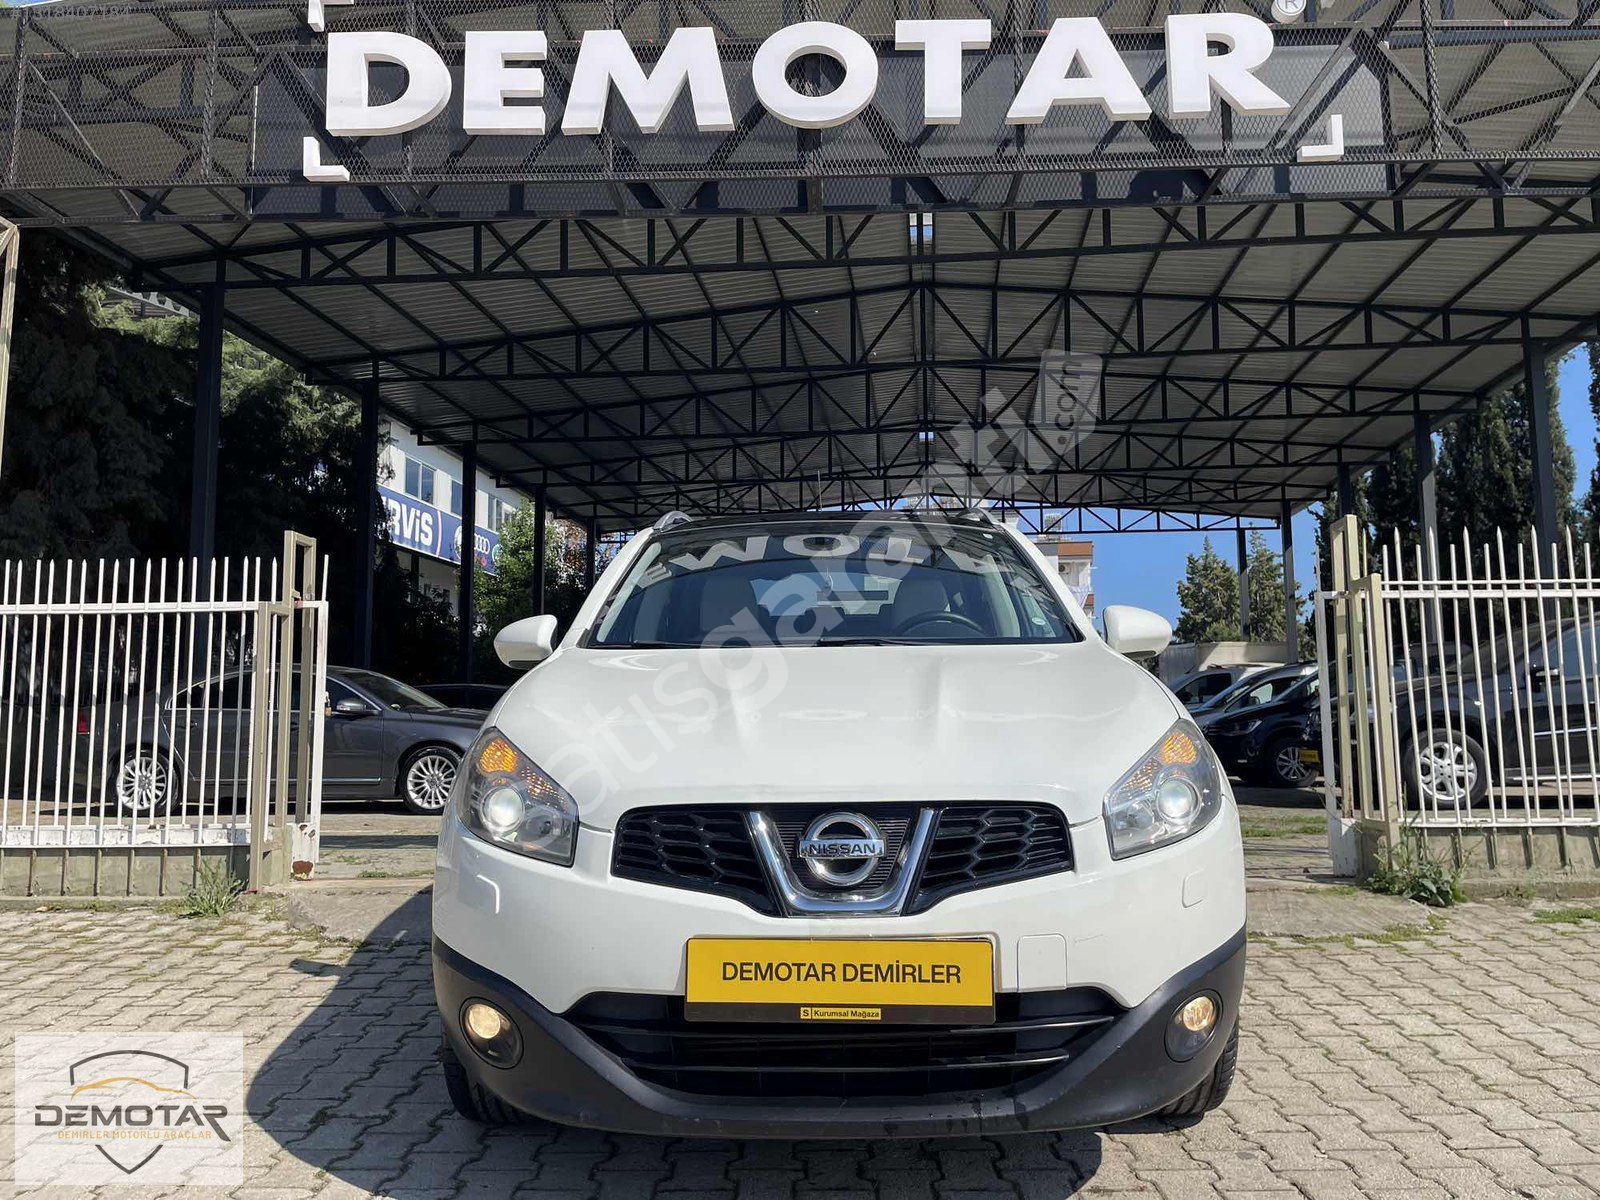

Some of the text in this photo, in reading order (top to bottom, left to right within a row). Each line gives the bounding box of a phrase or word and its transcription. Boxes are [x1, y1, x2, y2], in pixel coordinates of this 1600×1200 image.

[325, 12, 1292, 138] DEMOTAR
[808, 843, 876, 855] NISSAN
[722, 959, 962, 984] DEMOTAR DEMİRLER
[813, 1009, 849, 1017] Kurumsal
[850, 1009, 880, 1018] Mağaza
